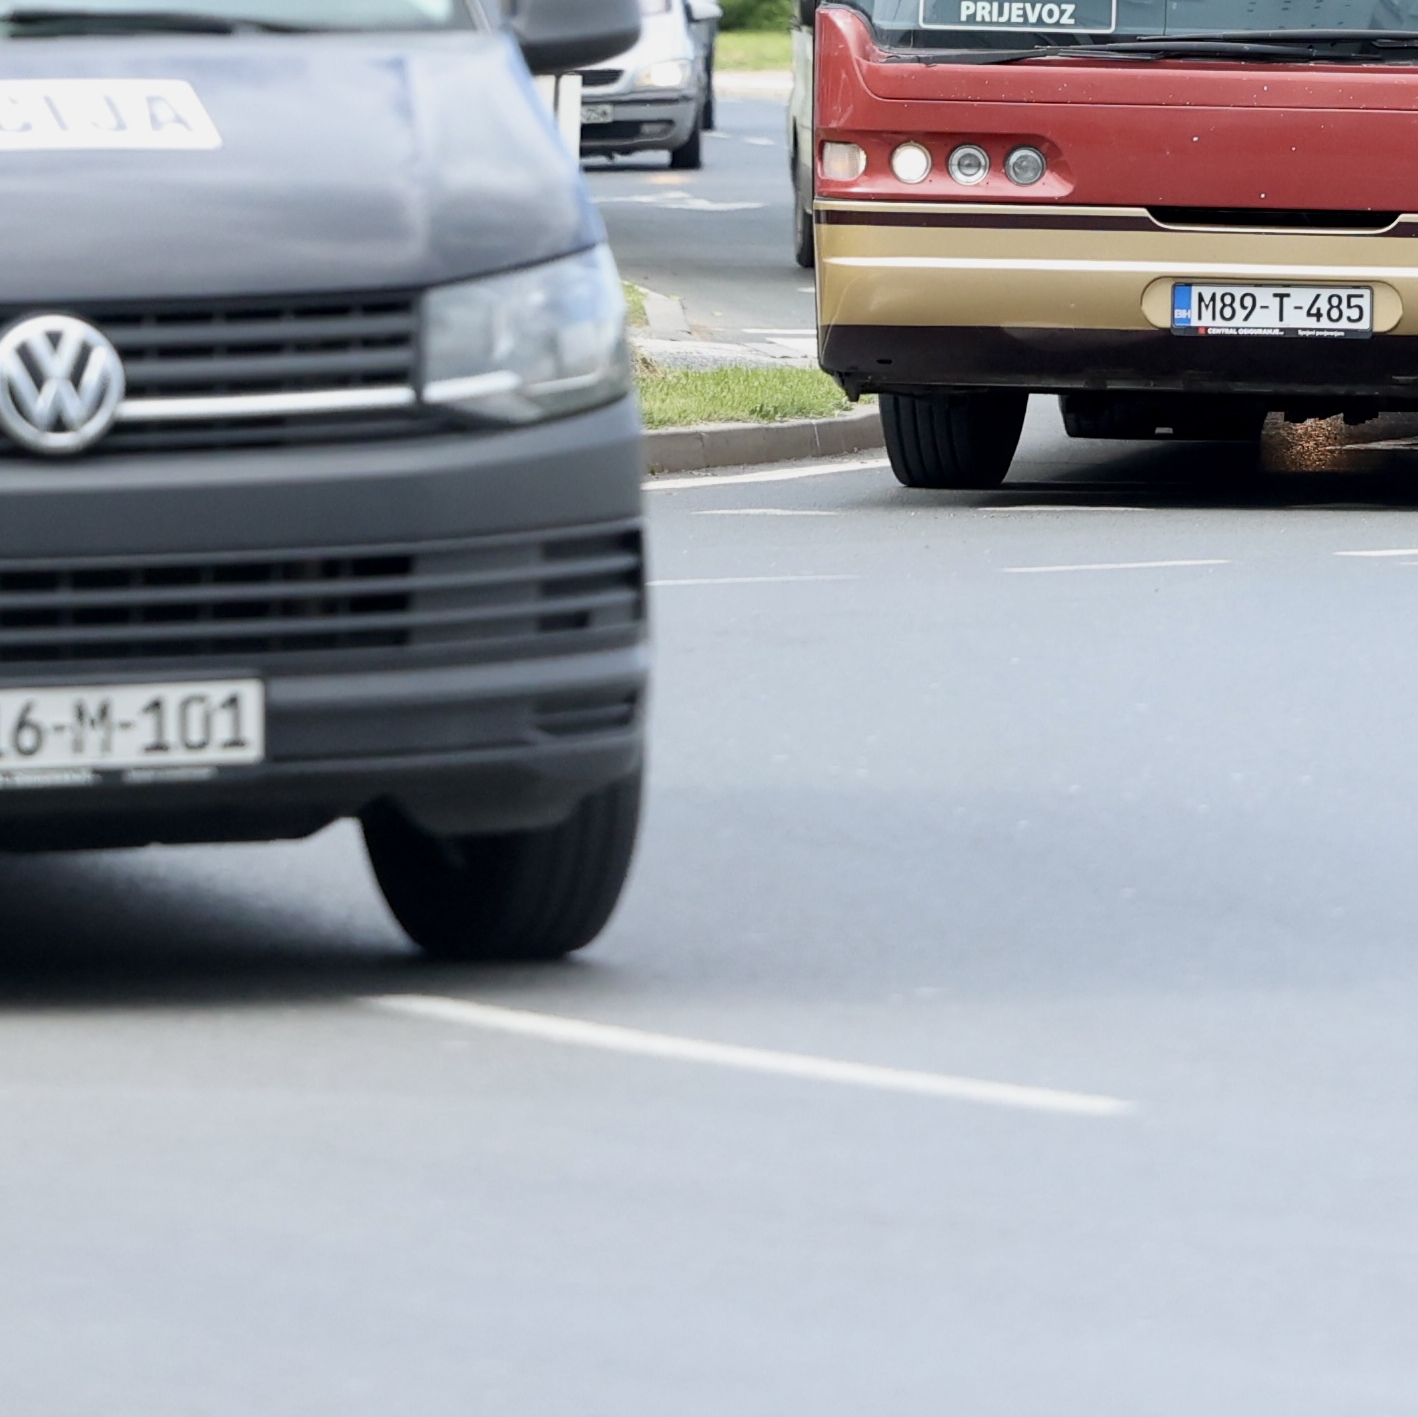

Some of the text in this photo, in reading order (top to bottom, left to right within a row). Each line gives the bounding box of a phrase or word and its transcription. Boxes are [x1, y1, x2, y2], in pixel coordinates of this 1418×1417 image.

[960, 0, 1076, 25] PRIJEVOZ
[1174, 309, 1191, 318] BIH
[1197, 291, 1365, 324] M89-T-485
[1207, 327, 1237, 335] CENTRAL
